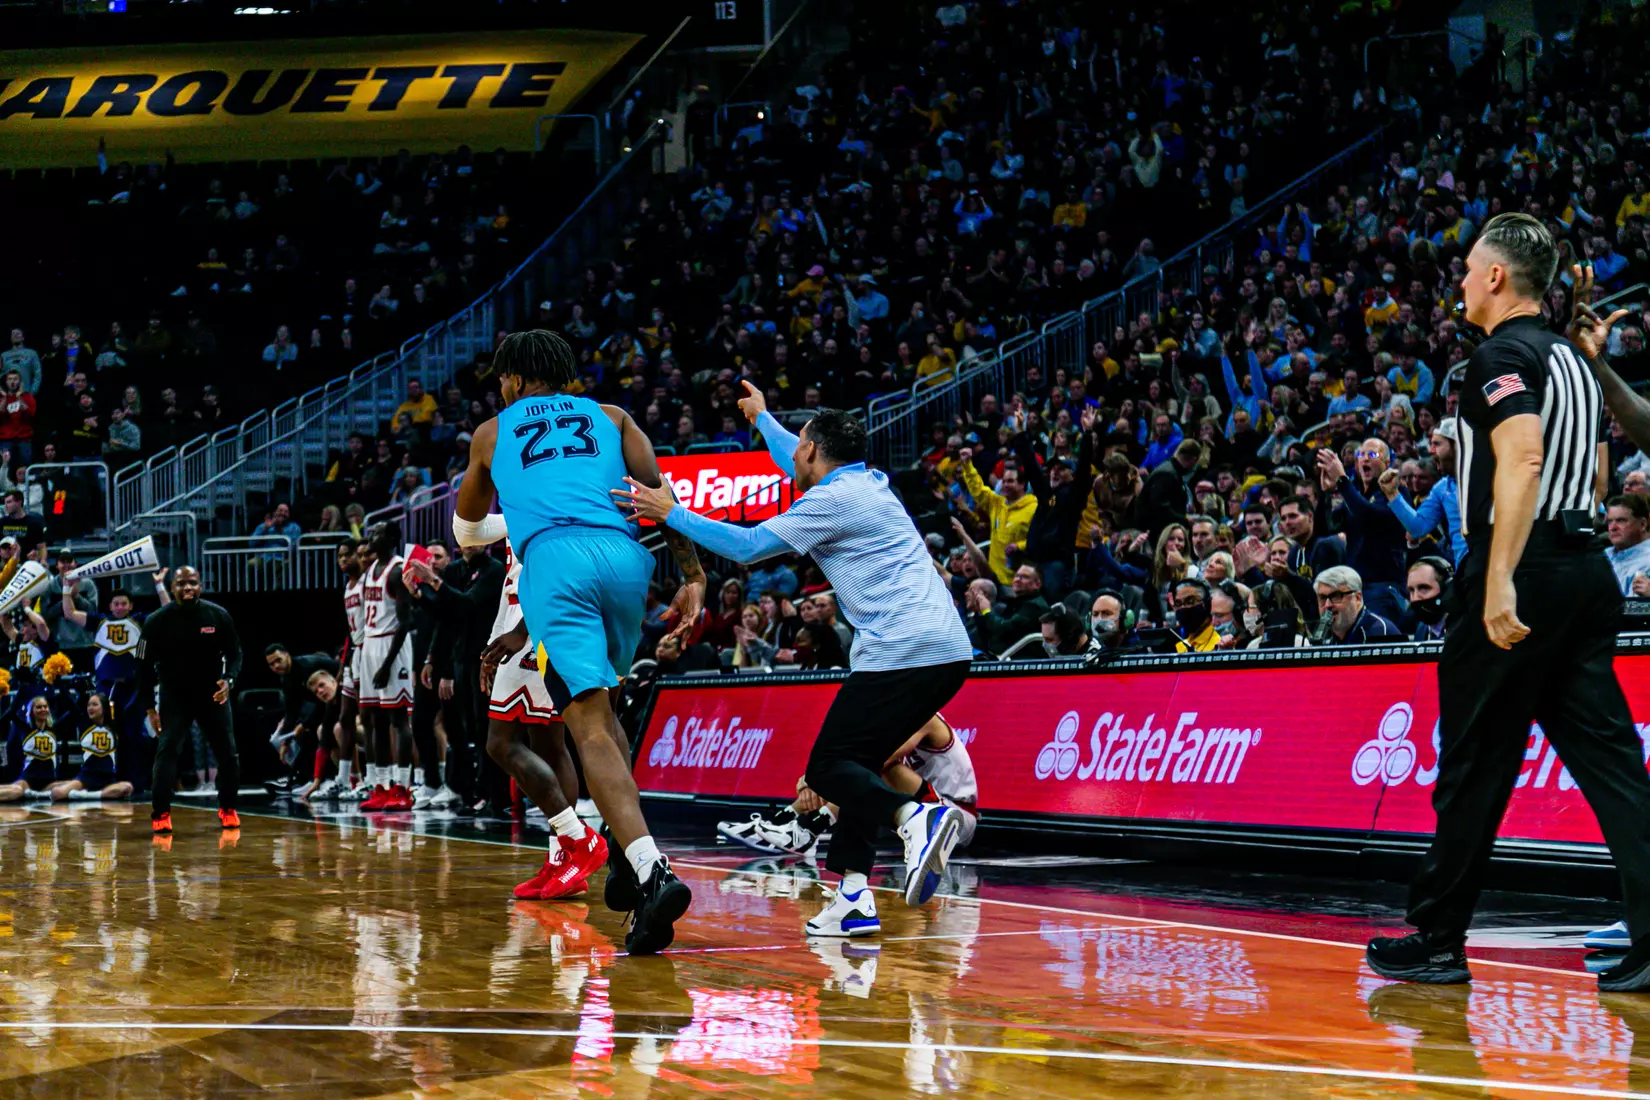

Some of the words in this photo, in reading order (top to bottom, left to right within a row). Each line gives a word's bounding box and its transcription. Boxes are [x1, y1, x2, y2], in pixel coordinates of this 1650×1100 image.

[714, 1, 737, 20] 113
[0, 62, 569, 119] ARQUETTE
[524, 401, 574, 418] JOPLIN
[513, 413, 600, 470] 23
[115, 547, 144, 569] OUT
[366, 605, 377, 628] 12
[106, 623, 130, 646] MU
[34, 736, 53, 754] MU
[91, 732, 111, 750] MU
